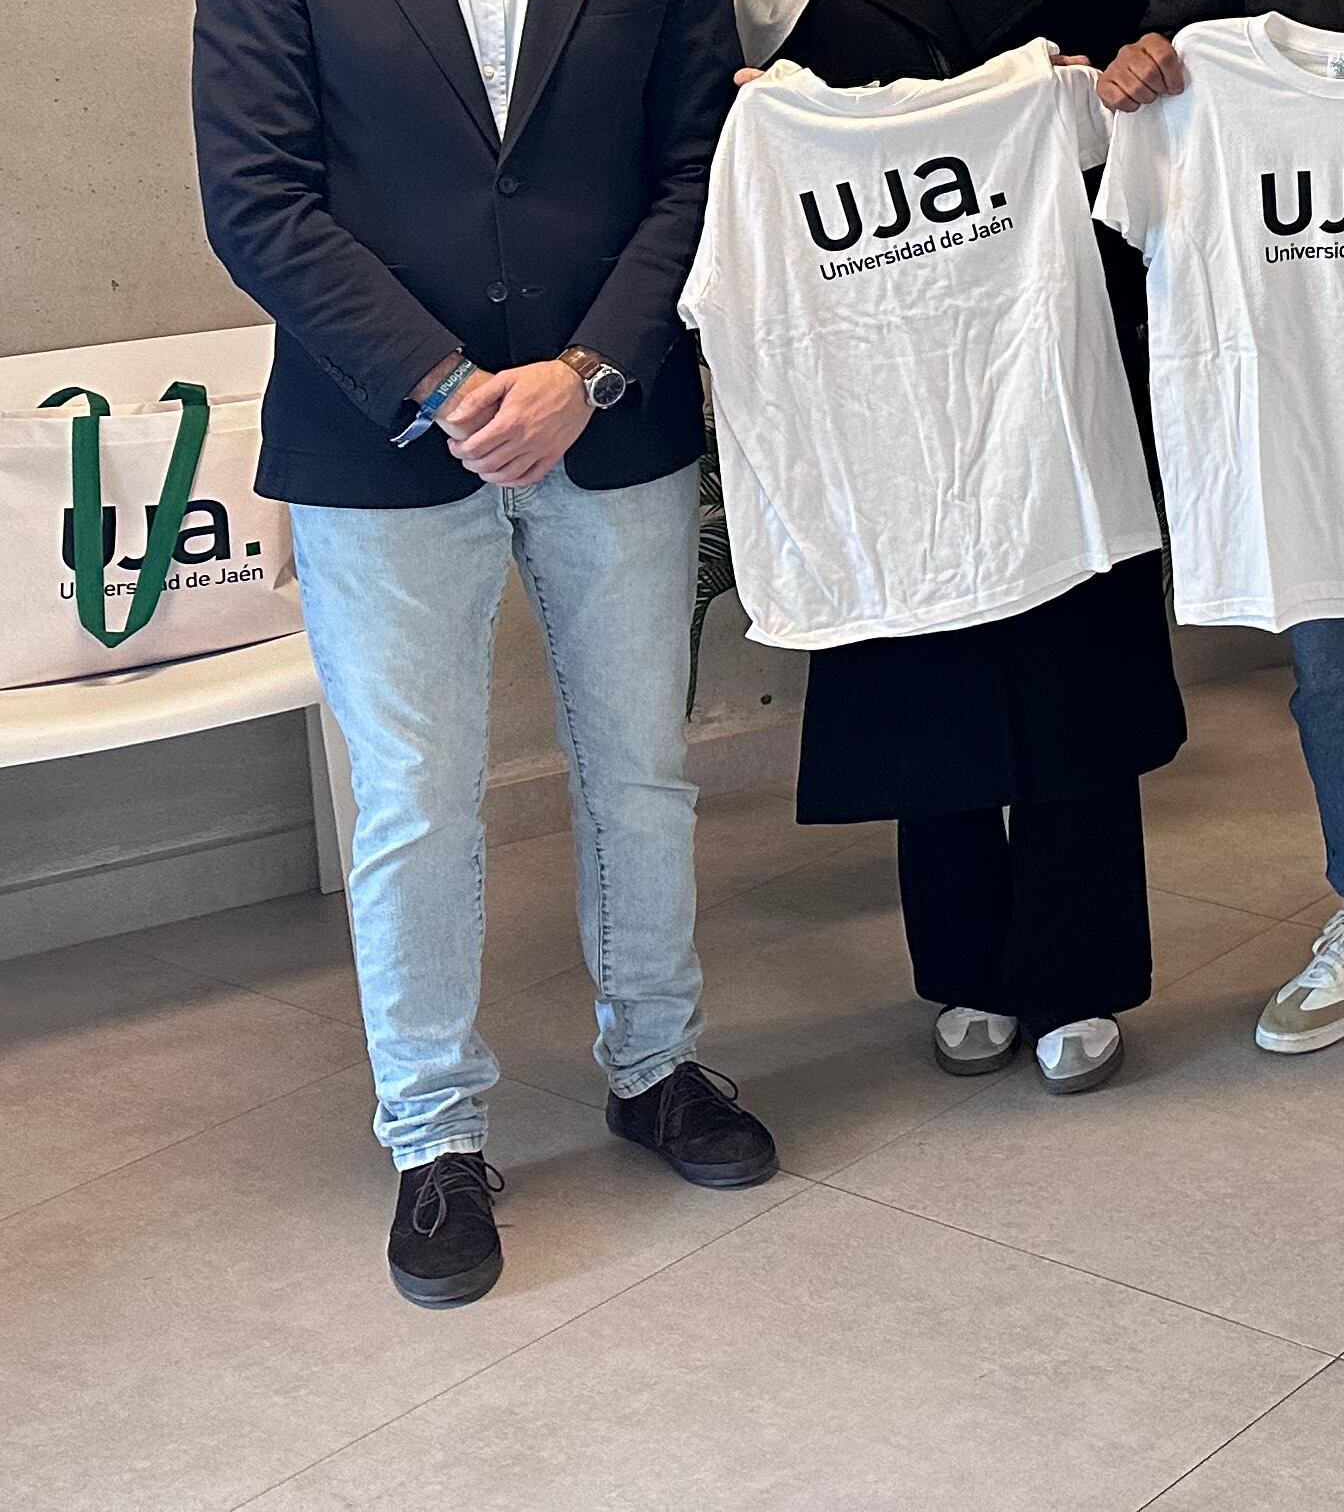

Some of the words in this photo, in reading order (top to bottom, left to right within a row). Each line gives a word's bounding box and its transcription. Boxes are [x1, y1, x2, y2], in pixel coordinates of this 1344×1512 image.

[819, 235, 937, 281] Universidad
[940, 230, 964, 249] de
[968, 216, 1014, 242] Jaén
[185, 571, 211, 589] de
[215, 564, 264, 585] Jaén
